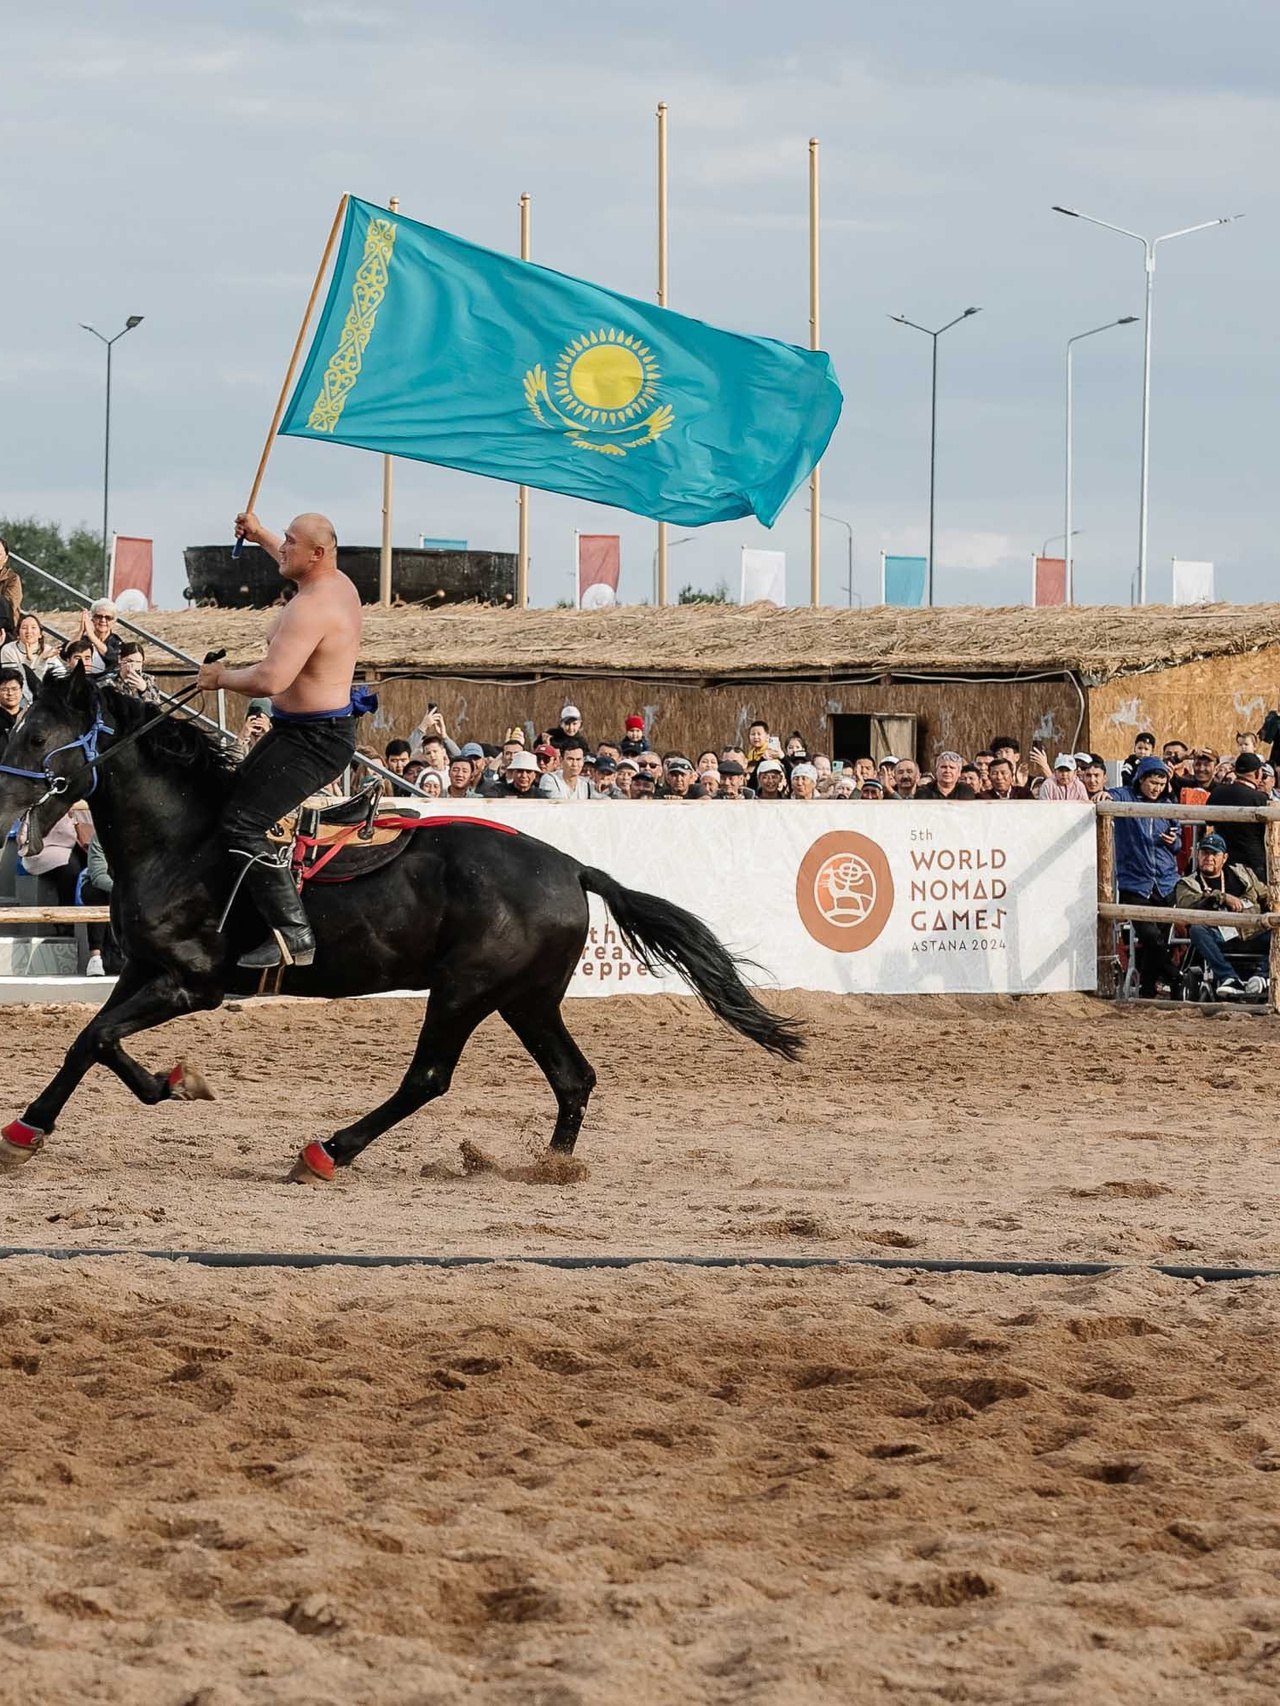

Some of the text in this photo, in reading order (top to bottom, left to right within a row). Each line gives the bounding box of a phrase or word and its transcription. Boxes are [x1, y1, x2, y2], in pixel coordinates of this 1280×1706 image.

[910, 829, 933, 841] 5th
[910, 849, 1006, 871] WORLD
[911, 879, 1007, 901] NOMAD
[911, 908, 1007, 931] GAMES
[589, 923, 632, 944] th
[581, 946, 637, 960] rea
[911, 939, 1006, 952] ASTANA 2024
[573, 962, 648, 981] eppe
